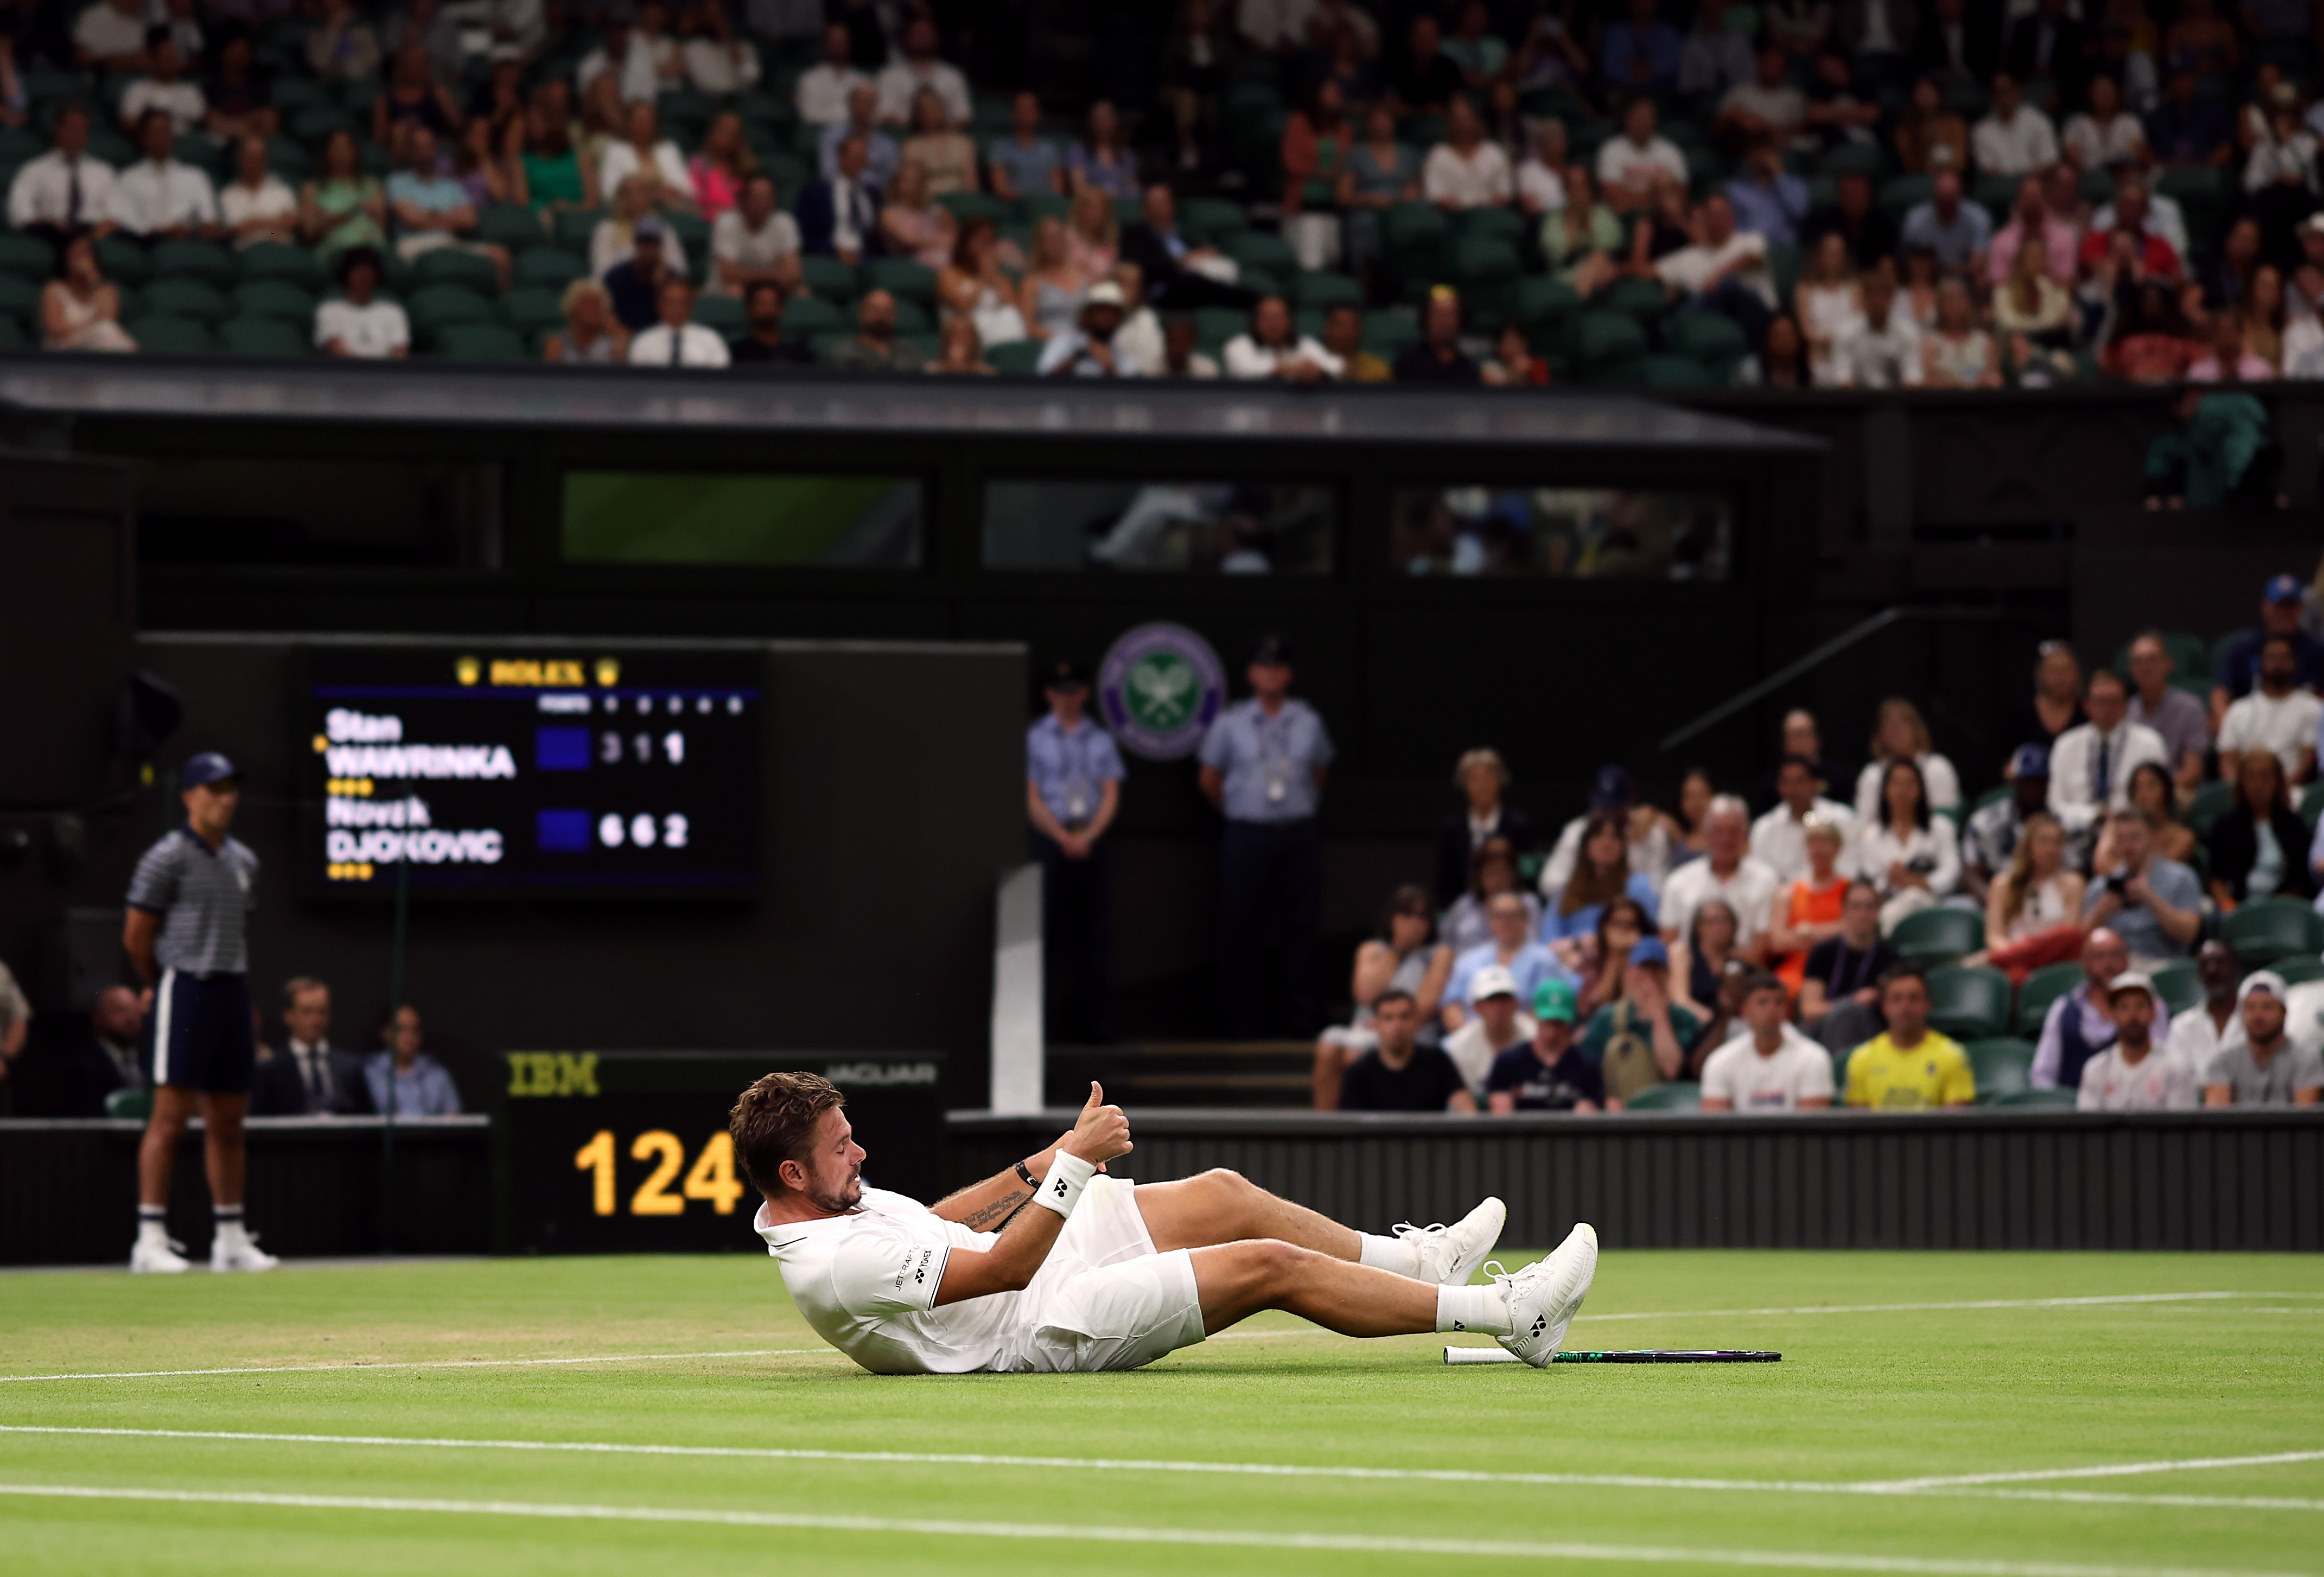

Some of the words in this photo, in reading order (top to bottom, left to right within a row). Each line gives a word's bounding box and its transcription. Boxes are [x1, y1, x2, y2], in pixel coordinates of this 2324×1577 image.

[490, 660, 584, 686] ROLEX
[664, 731, 684, 763] 1
[598, 813, 625, 847] 6
[631, 813, 657, 847] 6
[664, 813, 688, 847] 2
[507, 1051, 600, 1096] IBM
[575, 1129, 744, 1216] 124
[919, 1249, 932, 1267] YONEX
